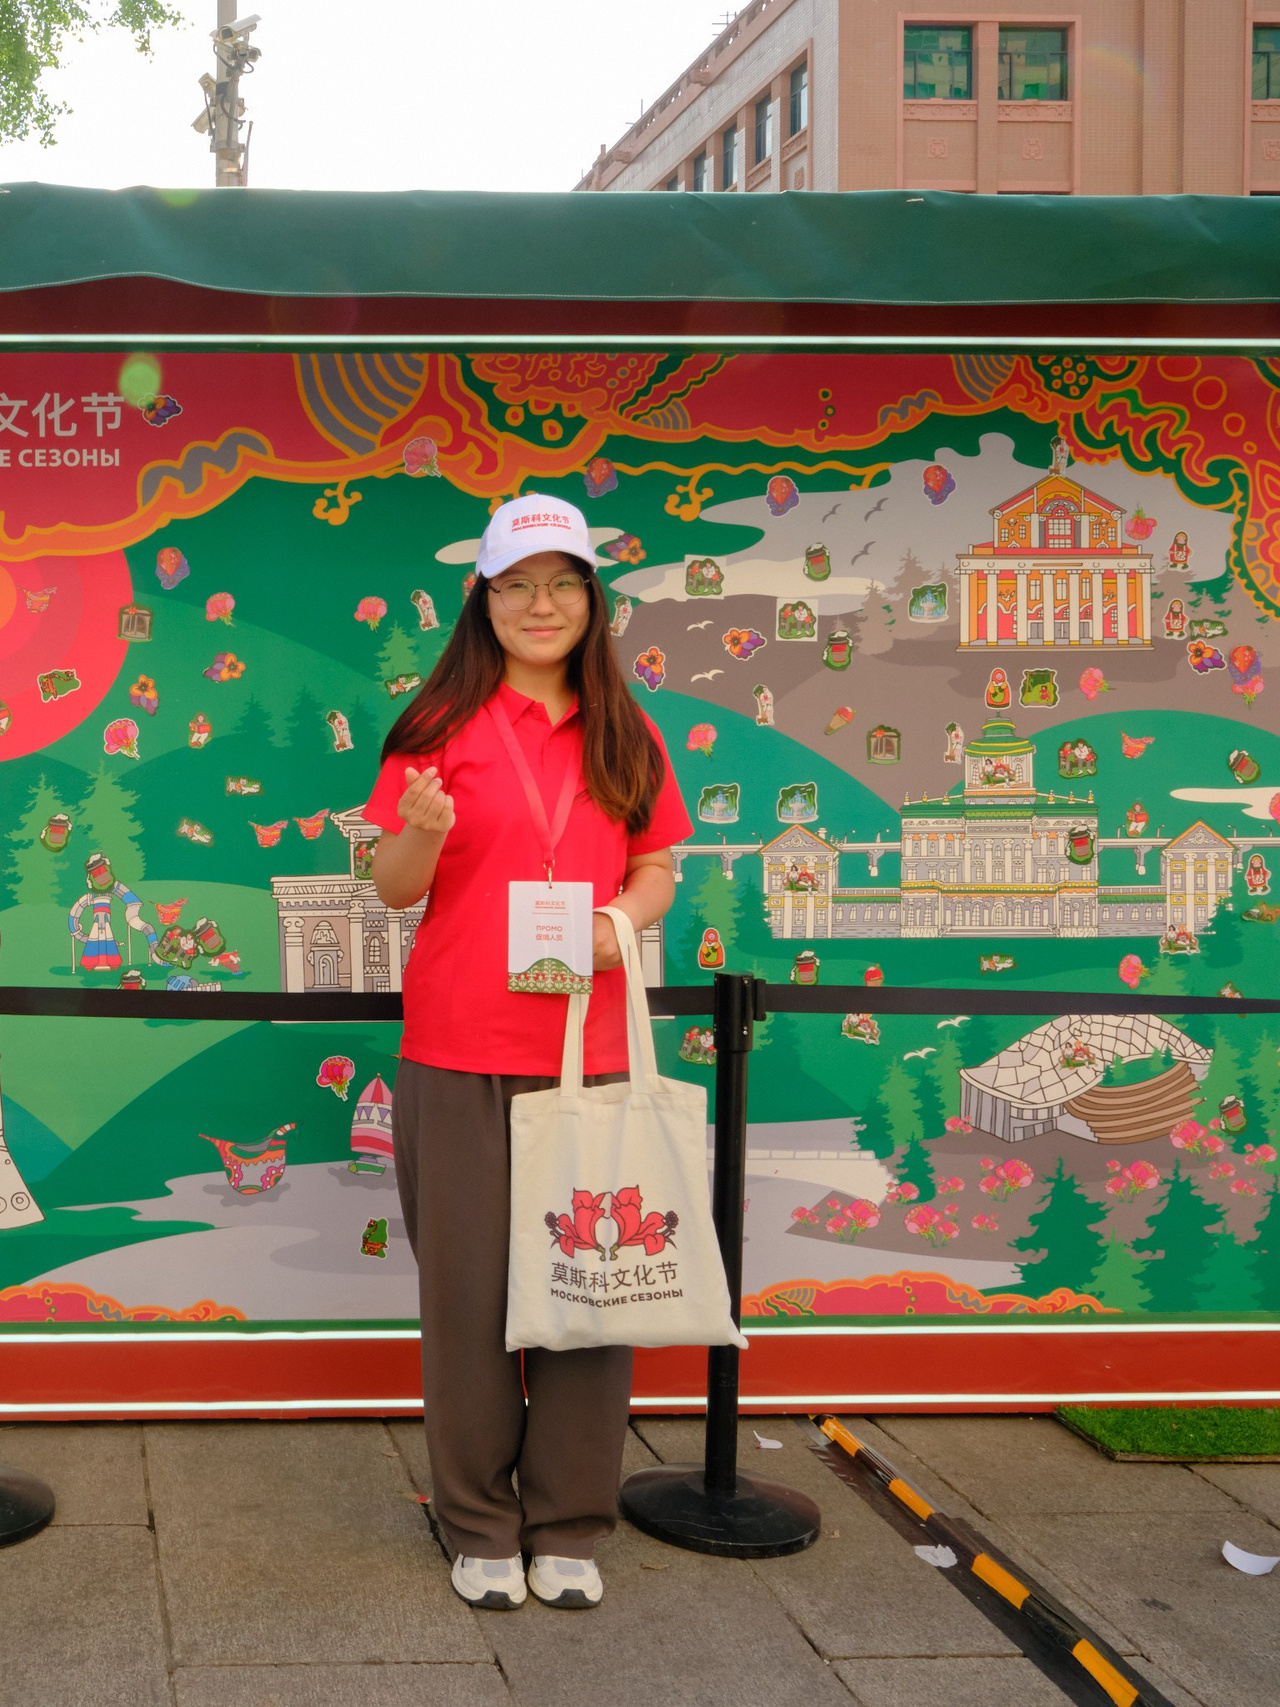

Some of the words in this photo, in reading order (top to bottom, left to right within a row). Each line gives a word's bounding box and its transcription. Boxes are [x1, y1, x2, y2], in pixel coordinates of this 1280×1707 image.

[18, 448, 120, 468] СЕЗОНЫ
[511, 513, 570, 528] 莫斯科文化节
[551, 1260, 678, 1293] 莫斯科文化节
[550, 1288, 628, 1308] МОСКОВСКИЕ
[630, 1288, 684, 1303] СЕЗОНЫ
